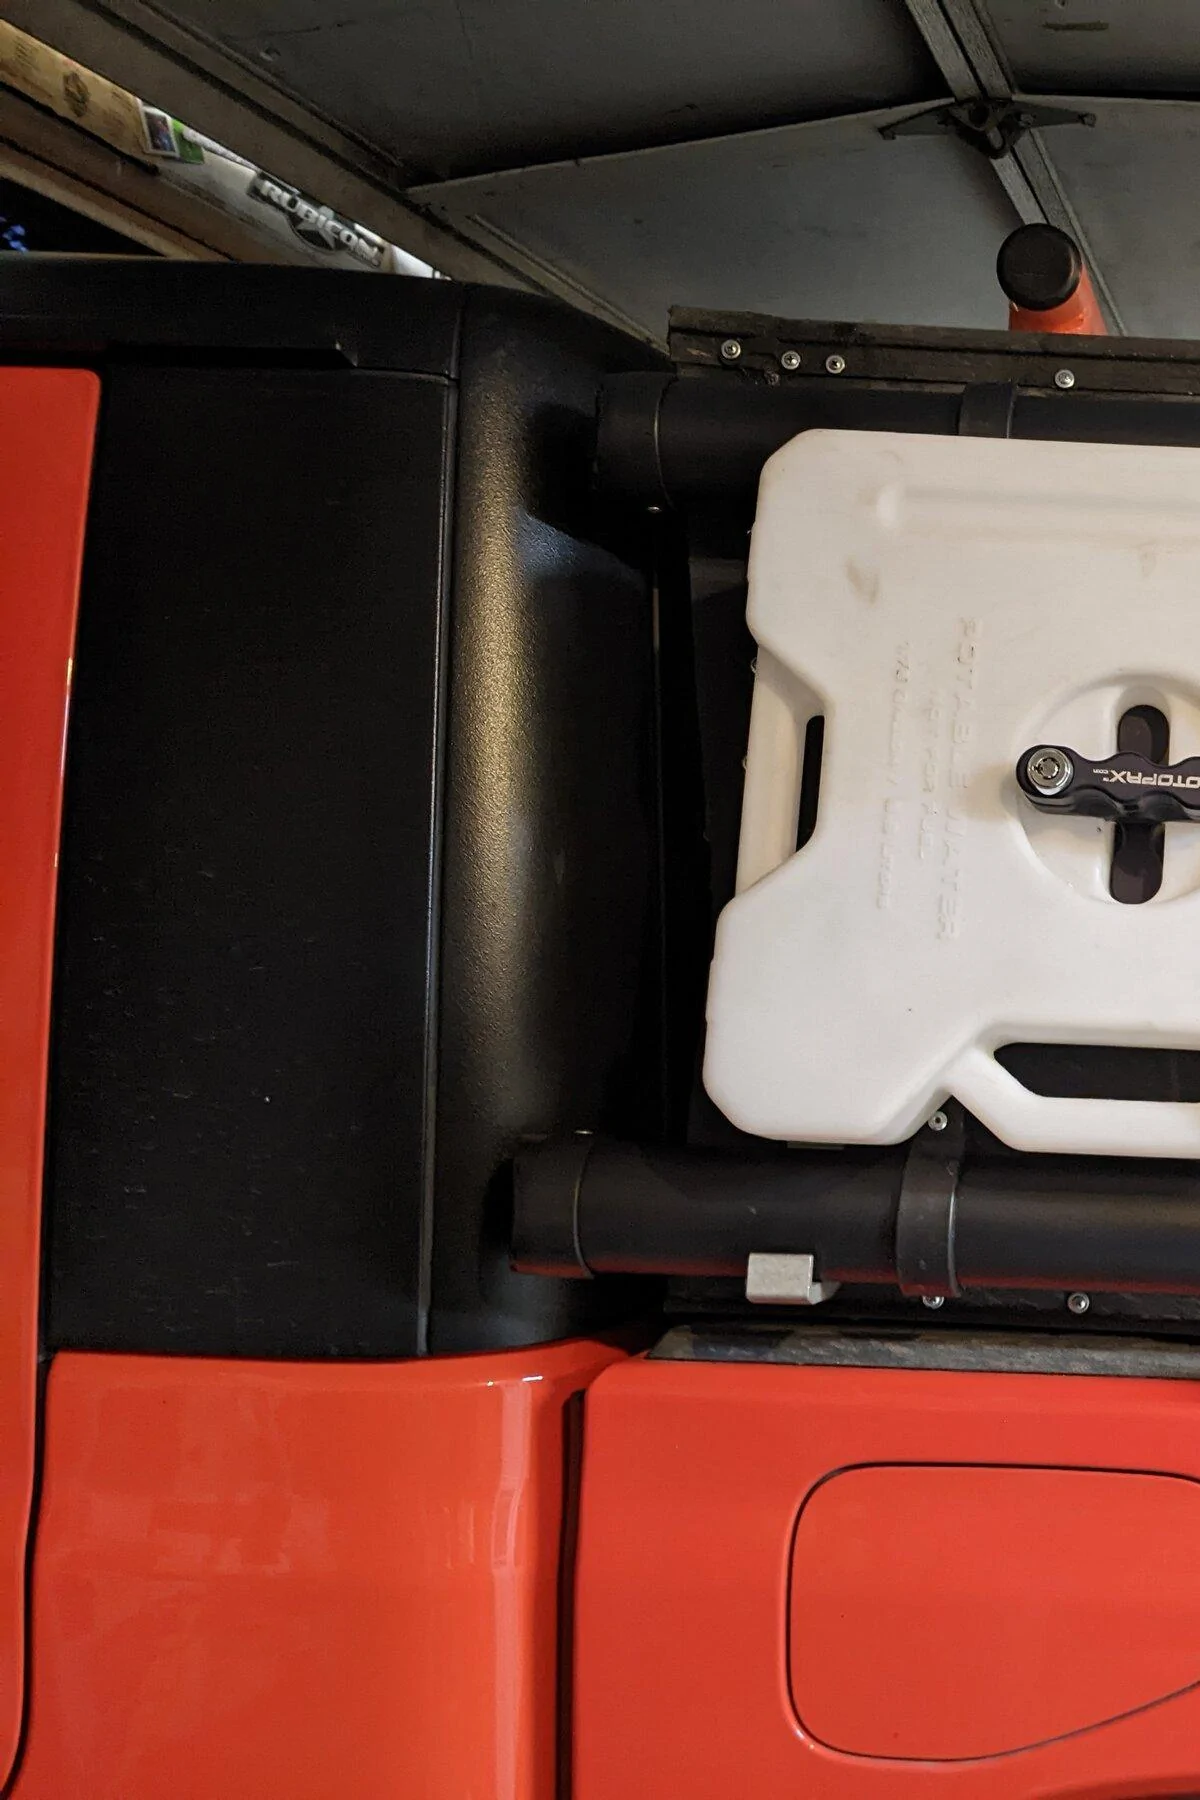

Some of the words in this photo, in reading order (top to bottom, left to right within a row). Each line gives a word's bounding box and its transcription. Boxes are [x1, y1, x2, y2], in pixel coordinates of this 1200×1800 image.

[259, 179, 380, 260] RUBICON
[946, 616, 982, 789] POTABLE
[935, 806, 969, 940] WATER
